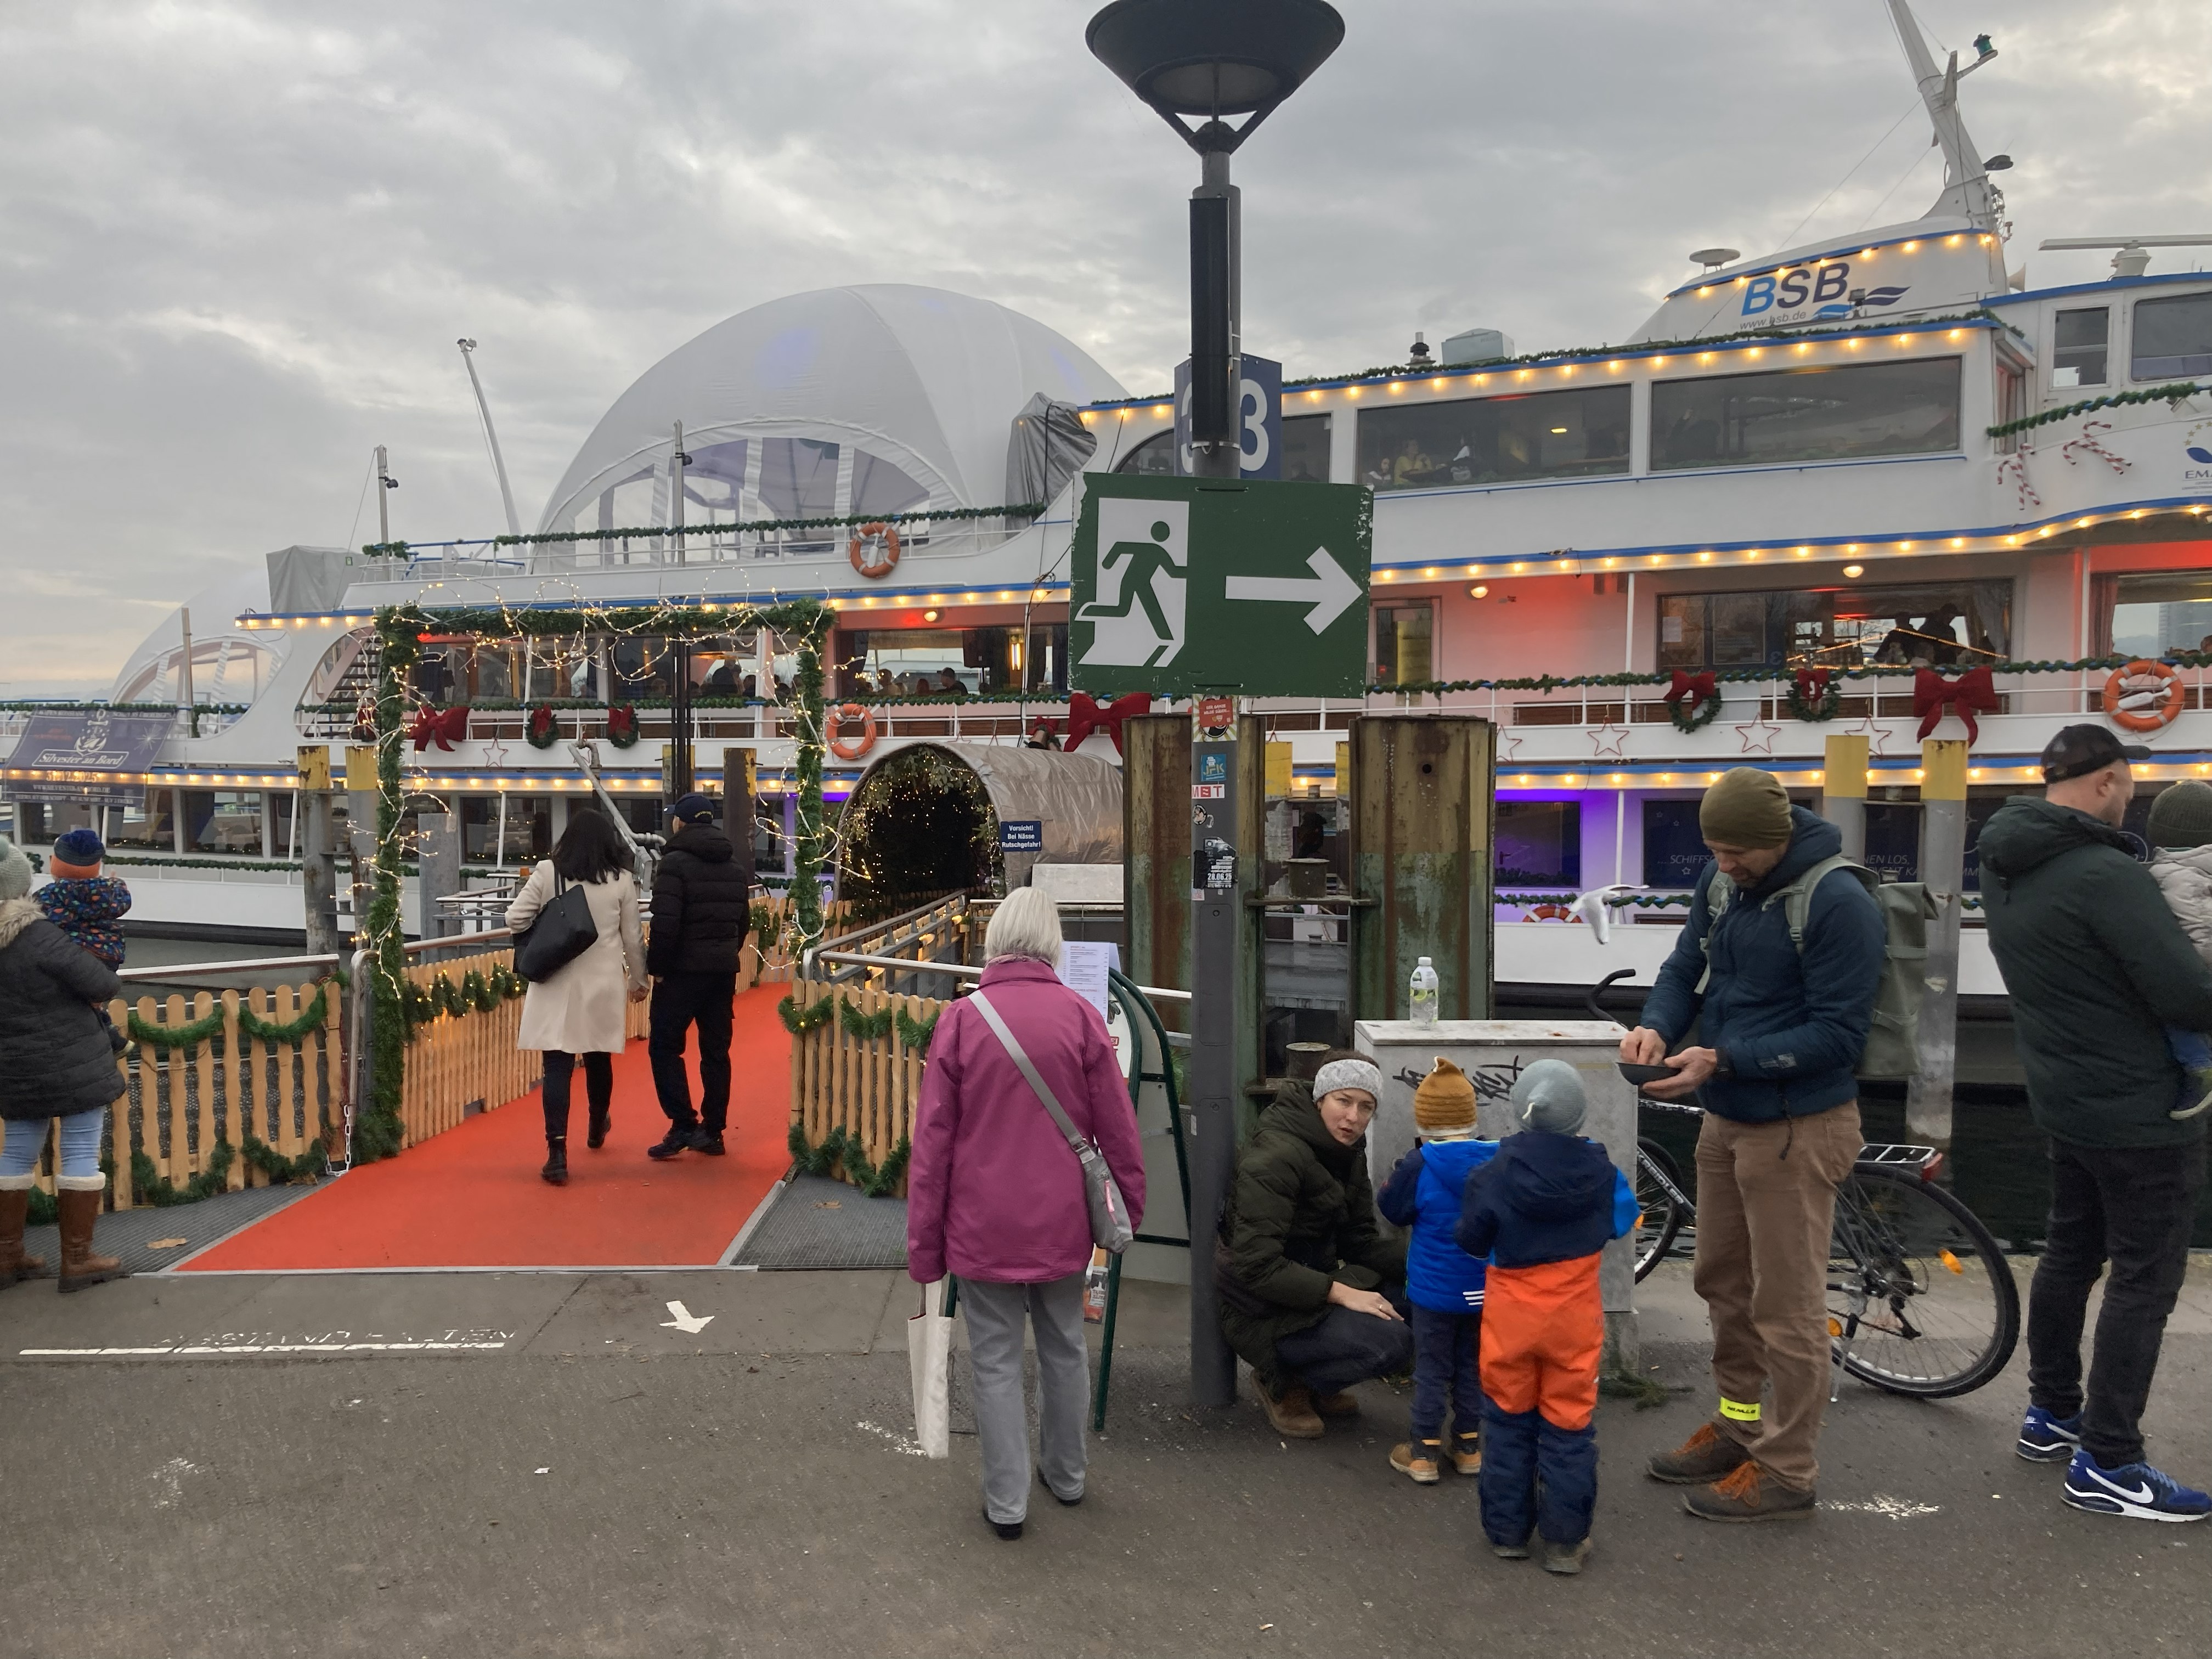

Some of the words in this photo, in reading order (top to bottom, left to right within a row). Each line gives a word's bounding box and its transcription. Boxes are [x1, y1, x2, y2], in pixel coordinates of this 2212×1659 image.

[1741, 263, 1849, 317] BSB
[1740, 311, 1806, 330] www.bsb.de
[1240, 379, 1269, 472] 3
[2185, 470, 2212, 479] EM
[39, 753, 83, 764] Silvester
[95, 755, 123, 765] Bord
